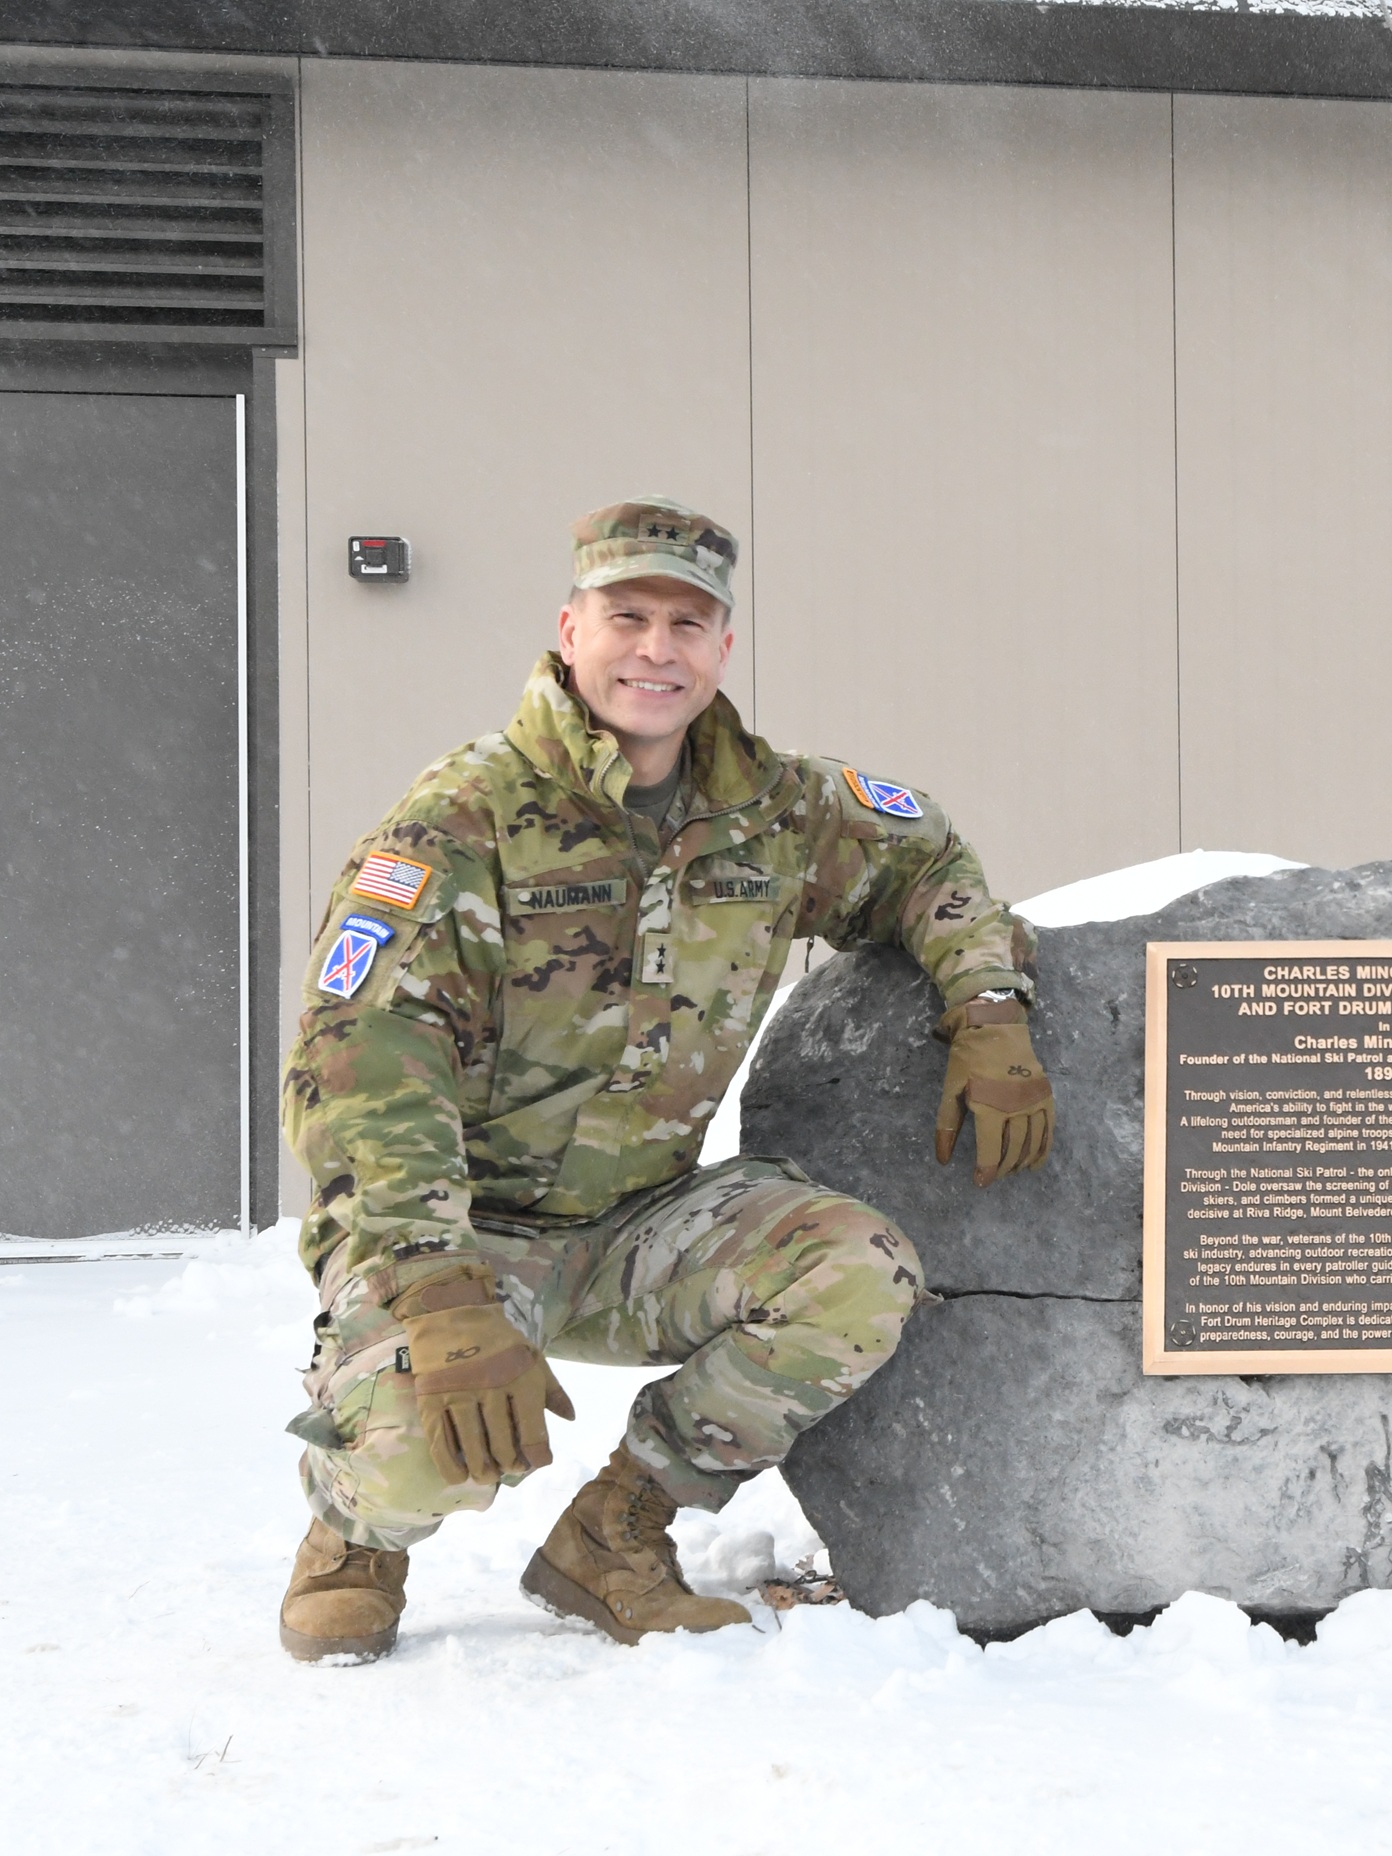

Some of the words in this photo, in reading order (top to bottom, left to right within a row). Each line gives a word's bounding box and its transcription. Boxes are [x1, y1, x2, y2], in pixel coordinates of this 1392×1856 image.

[530, 883, 612, 910] NAUMANN
[345, 917, 390, 939] MOUNTAIN
[1263, 965, 1351, 980] CHARLES
[1211, 983, 1255, 999] 10TH
[1261, 982, 1357, 998] MOUNTAIN
[1237, 1001, 1277, 1016] AND
[1283, 1000, 1333, 1016] FORT
[1338, 1000, 1392, 1015] DRUM
[1378, 1020, 1391, 1032] In
[1293, 1034, 1358, 1049] Charles
[1179, 1053, 1230, 1065] Founder
[1232, 1052, 1246, 1064] of
[1247, 1053, 1268, 1064] the
[1270, 1052, 1321, 1064] National
[1323, 1052, 1344, 1063] Ski
[1346, 1051, 1383, 1063] Patrol
[1183, 1089, 1226, 1103] Through
[1228, 1089, 1263, 1101] vision,
[1265, 1088, 1320, 1100] conviction,
[1323, 1088, 1343, 1099] and
[1179, 1115, 1189, 1127] A
[1190, 1115, 1228, 1129] lifelong
[1230, 1114, 1298, 1126] outdoorsman
[1300, 1114, 1320, 1125] and
[1322, 1114, 1362, 1125] founder
[1364, 1113, 1376, 1125] of
[1212, 1141, 1260, 1153] Mountain
[1262, 1140, 1302, 1154] Infantry
[1304, 1140, 1354, 1154] Regiment
[1356, 1139, 1367, 1151] in
[1184, 1167, 1227, 1181] Through
[1230, 1167, 1247, 1178] the
[1249, 1167, 1293, 1178] National
[1296, 1166, 1313, 1178] Ski
[1315, 1166, 1347, 1178] Patrol
[1356, 1166, 1375, 1177] the
[1199, 1233, 1239, 1248] Beyond
[1241, 1233, 1259, 1245] the
[1261, 1235, 1284, 1246] war,
[1286, 1233, 1332, 1244] veterans
[1334, 1232, 1346, 1244] of
[1348, 1232, 1366, 1244] the
[1368, 1232, 1392, 1244] 10th
[1197, 1261, 1232, 1275] legacy
[1234, 1260, 1277, 1272] endures
[1279, 1260, 1290, 1271] in
[1292, 1261, 1322, 1273] every
[1324, 1259, 1369, 1273] patroller
[1185, 1302, 1196, 1314] In
[1198, 1301, 1230, 1314] honor
[1231, 1301, 1244, 1313] of
[1245, 1301, 1262, 1313] his
[1264, 1300, 1296, 1312] vision
[1298, 1300, 1319, 1312] and
[1321, 1300, 1368, 1314] enduring
[1199, 1328, 1271, 1343] preparedness,
[1273, 1329, 1317, 1342] courage,
[1320, 1327, 1340, 1339] and
[1342, 1327, 1359, 1339] the
[1361, 1329, 1392, 1341] power
